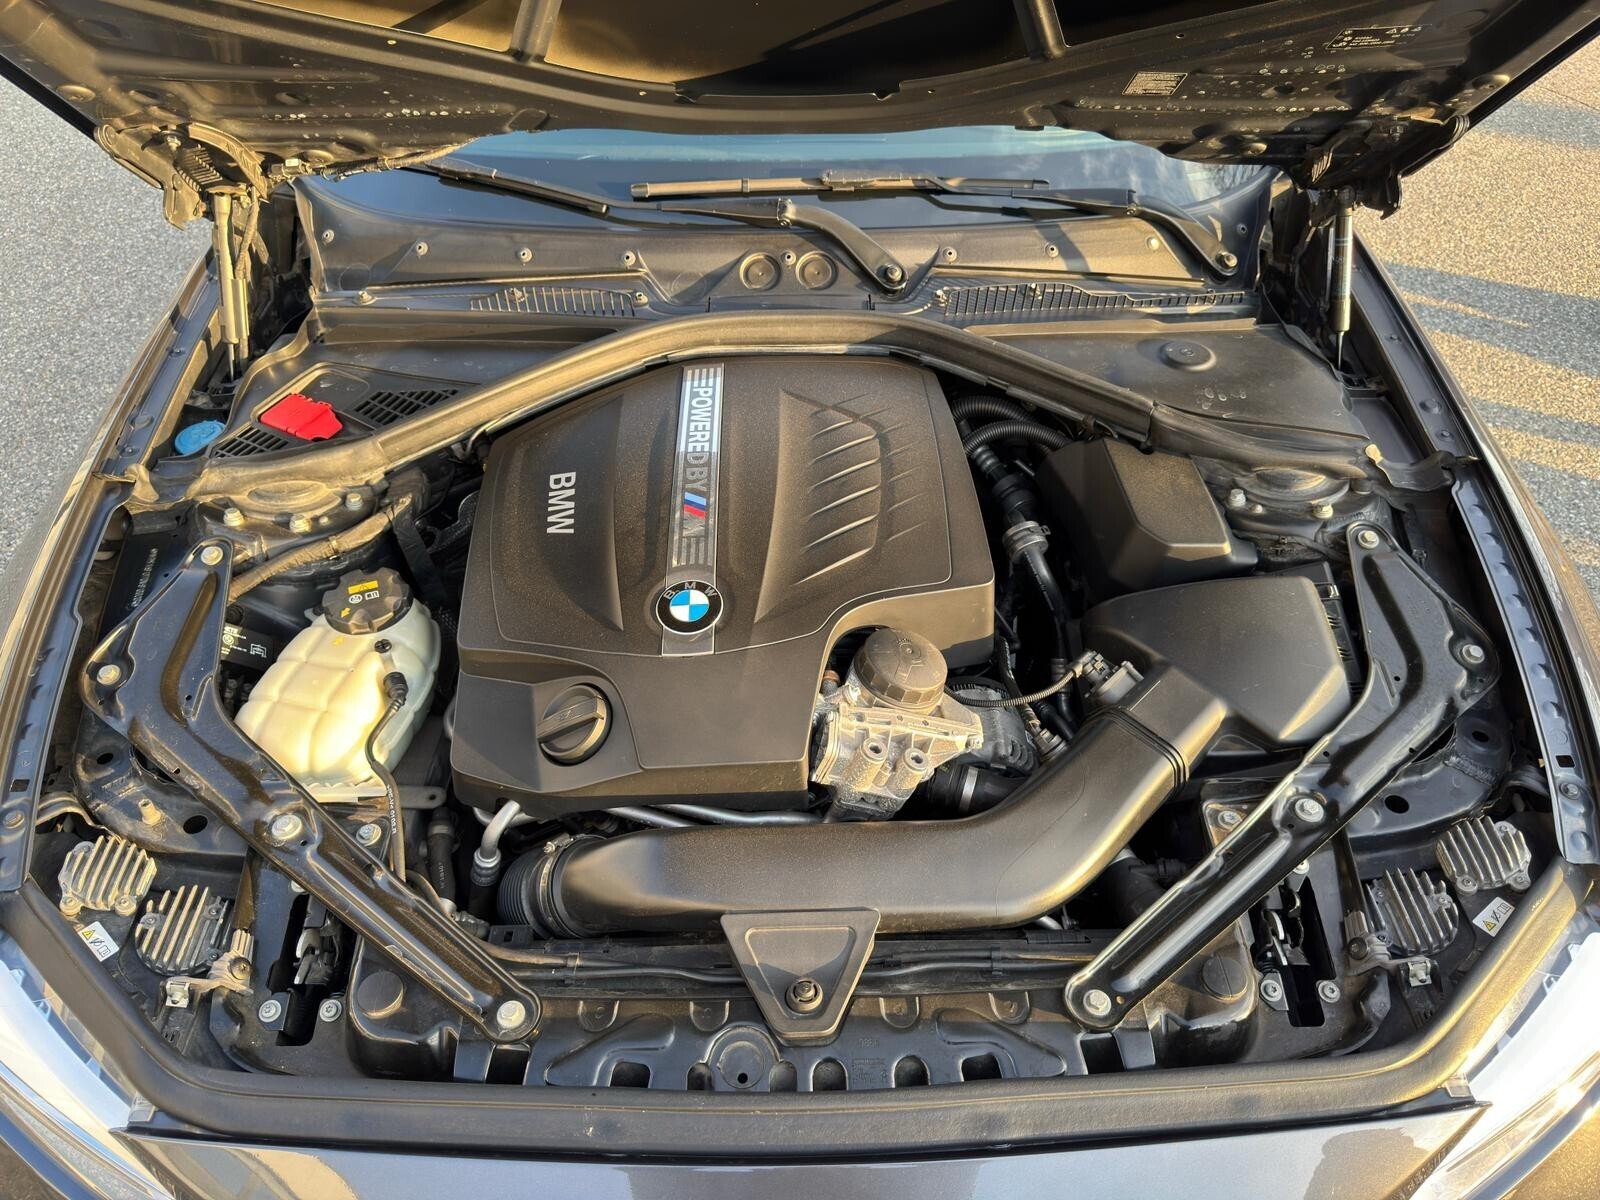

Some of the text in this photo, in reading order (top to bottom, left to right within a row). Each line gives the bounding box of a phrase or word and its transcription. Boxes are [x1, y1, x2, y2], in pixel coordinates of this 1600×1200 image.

[686, 387, 713, 464] POWERED
[685, 467, 709, 491] BY
[546, 471, 577, 534] BMW
[663, 581, 718, 600] BMW
